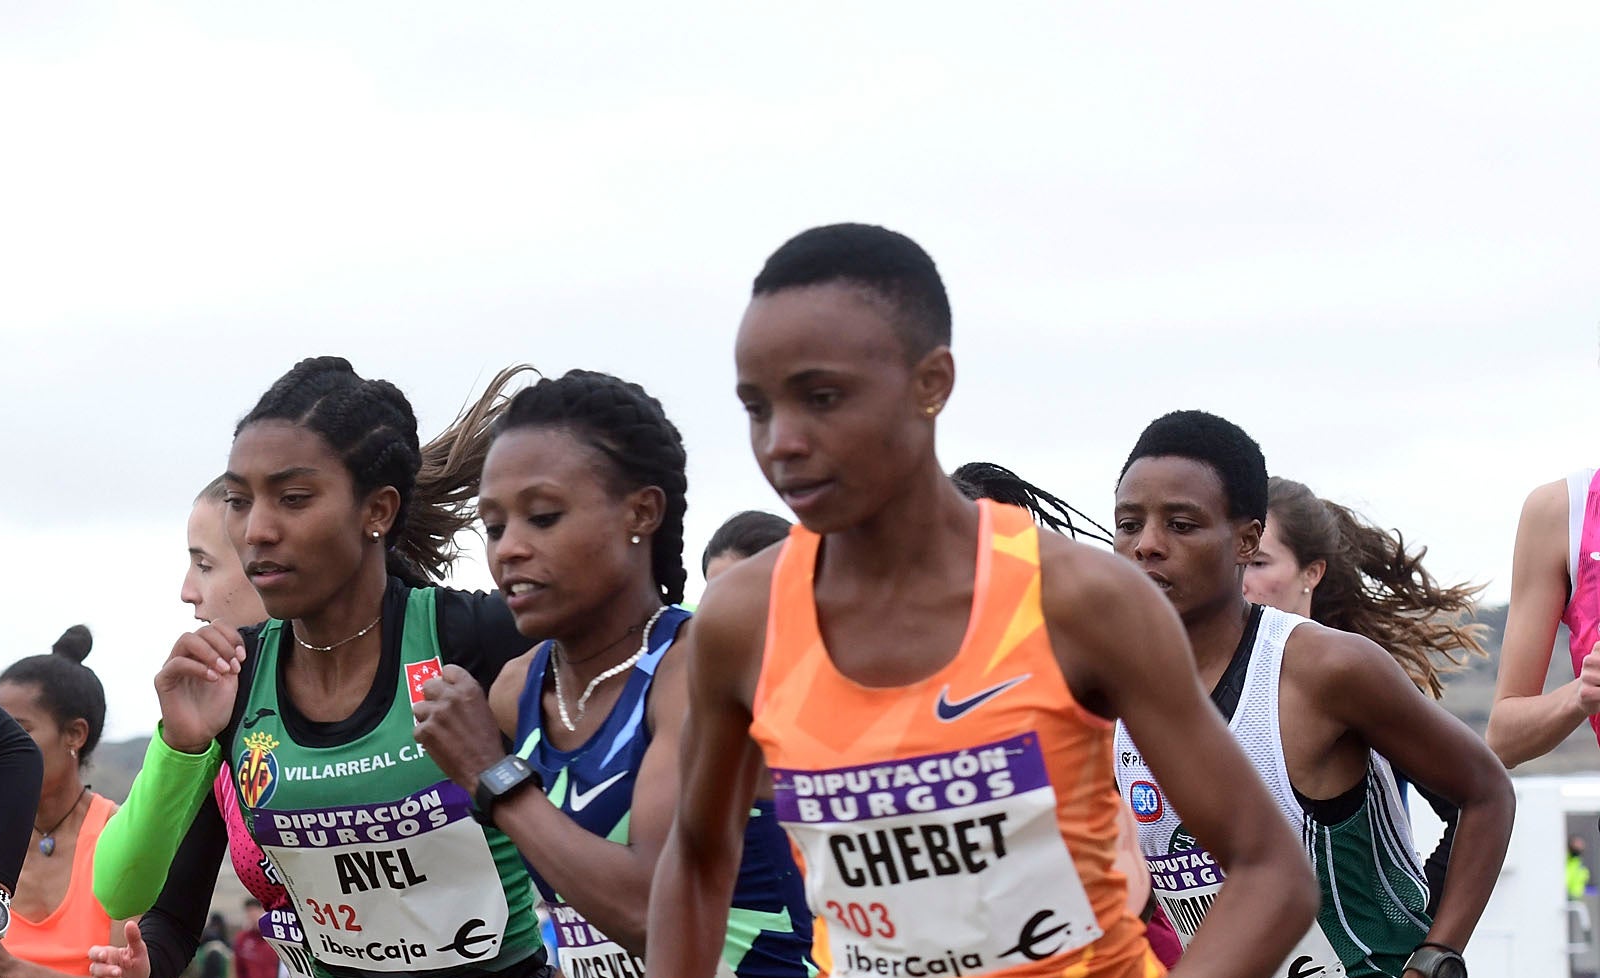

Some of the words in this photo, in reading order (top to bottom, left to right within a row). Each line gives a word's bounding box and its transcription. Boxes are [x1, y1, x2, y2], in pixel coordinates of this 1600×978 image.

[284, 752, 396, 781] VILLARREAL
[793, 746, 1008, 797] DIPUTACIÓN
[273, 789, 442, 829] DIPUTACIÓN
[797, 770, 1015, 822] BURGOS
[278, 808, 448, 847] BURGOS
[828, 812, 1007, 888] CHEBET
[333, 848, 428, 895] AYEL
[1152, 867, 1228, 891] BURG
[306, 898, 363, 932] 312
[826, 901, 896, 939] 303
[319, 934, 428, 964] iberCaja
[845, 945, 984, 977] iberCaja
